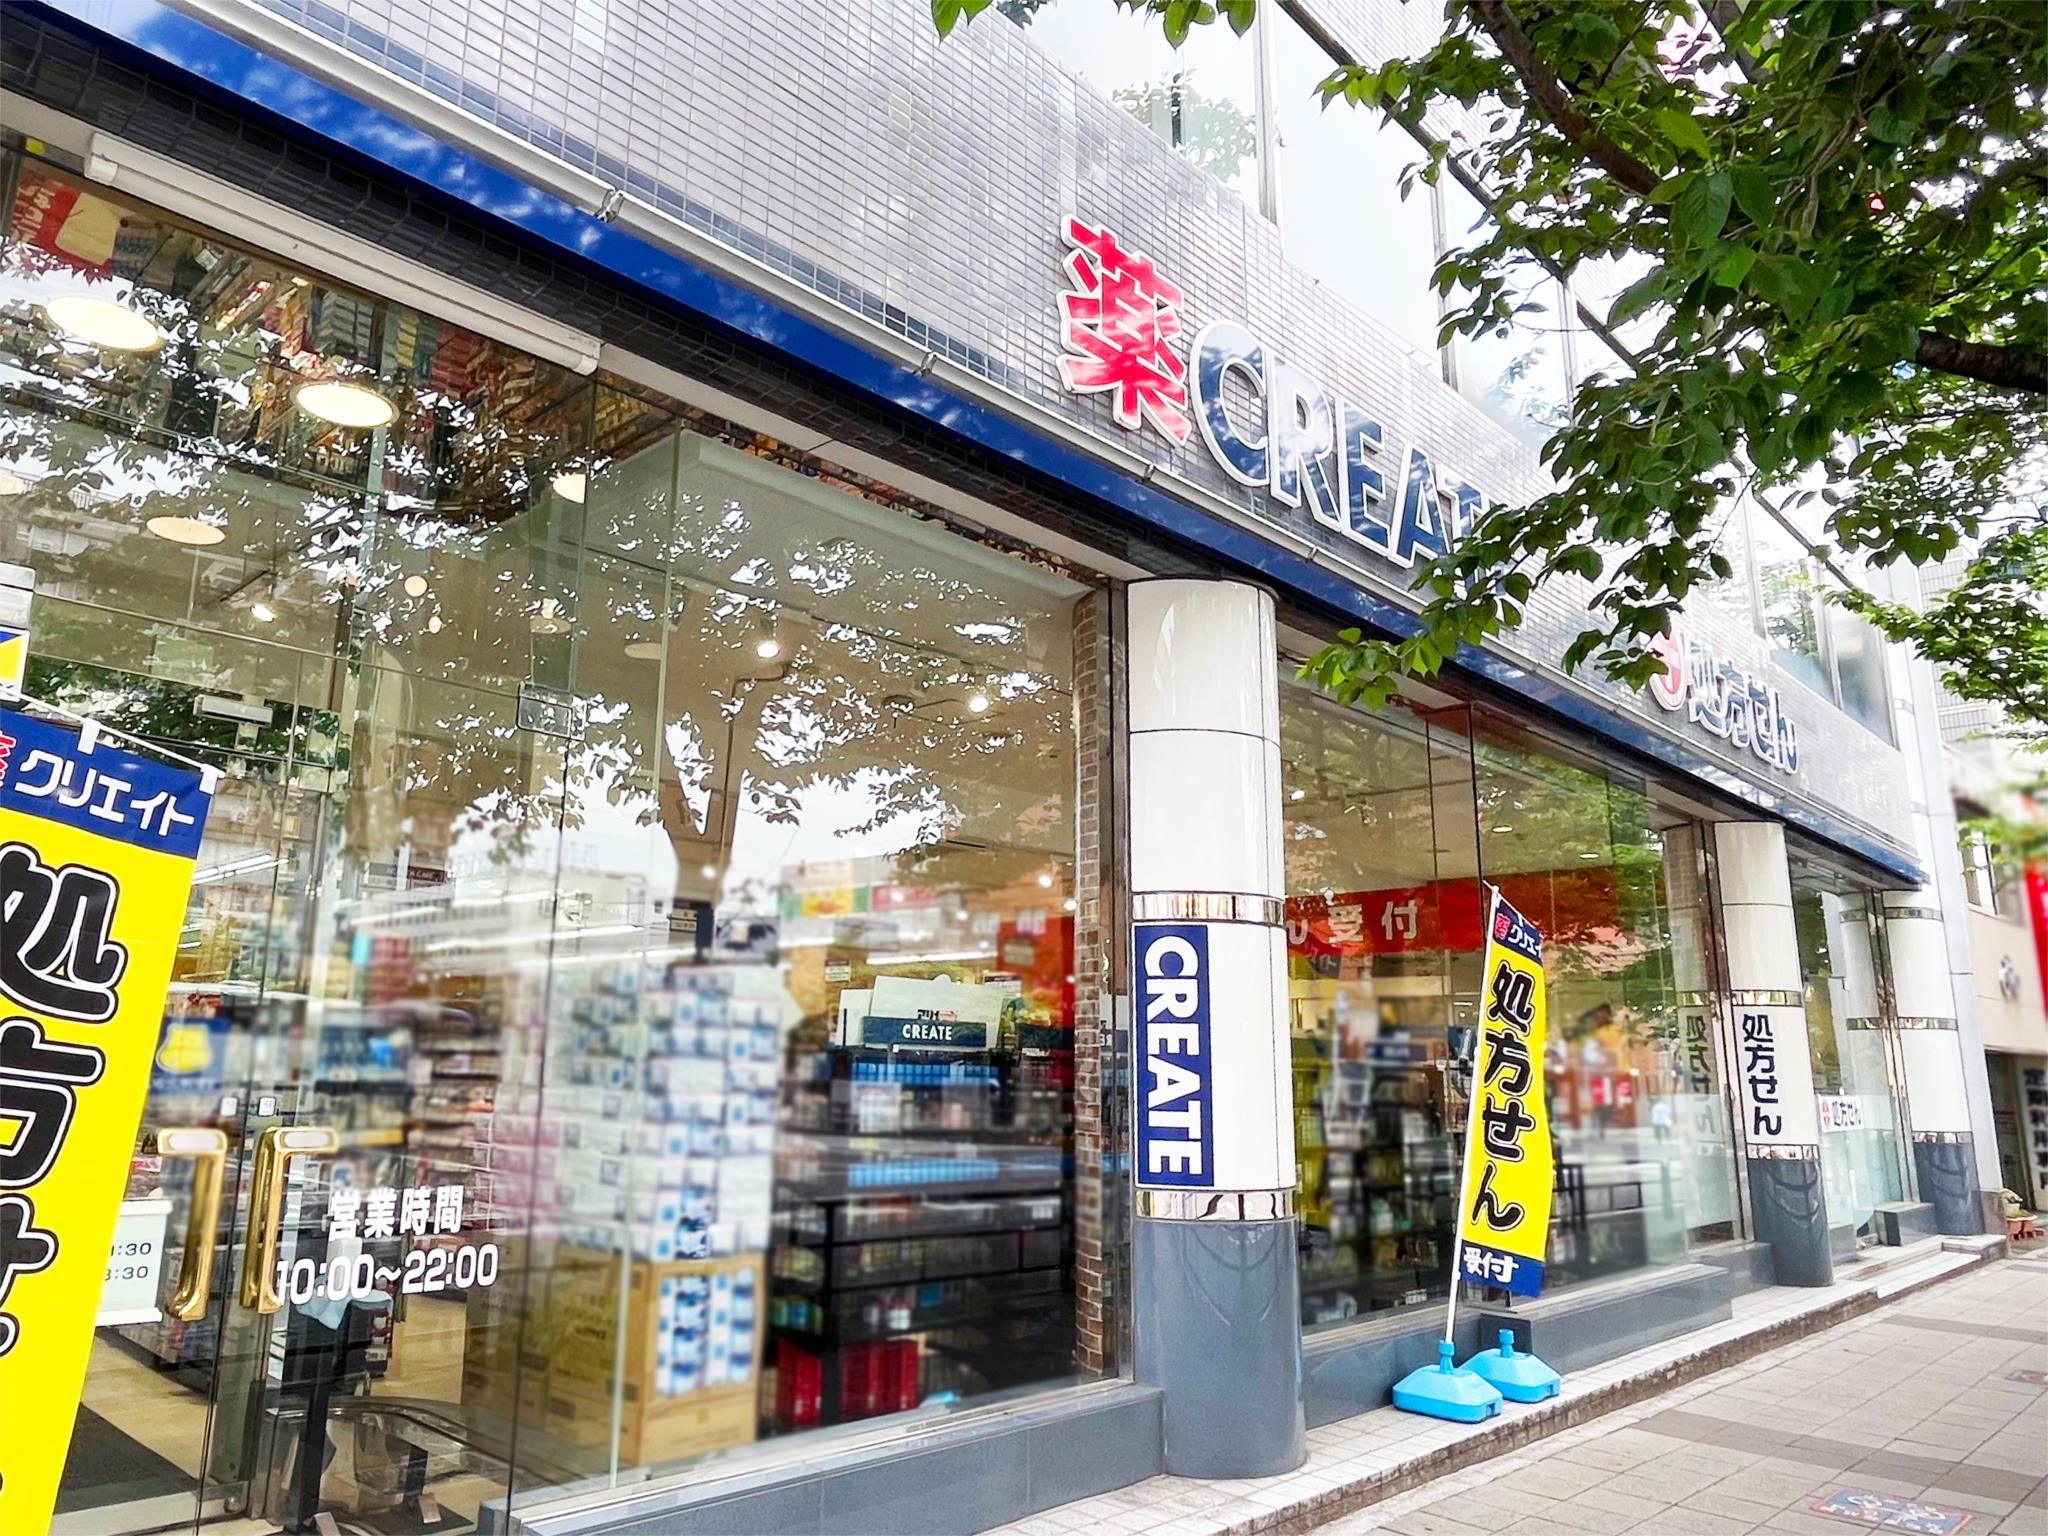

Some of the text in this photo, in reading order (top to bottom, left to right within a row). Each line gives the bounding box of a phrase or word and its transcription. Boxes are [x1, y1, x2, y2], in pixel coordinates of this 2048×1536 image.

[1056, 213, 1192, 448] 薬
[1189, 321, 1527, 632] CREAT
[1688, 638, 1800, 775] 処方せん
[14, 749, 196, 837] クリエイト
[902, 1024, 952, 1041] CREATE
[1144, 935, 1203, 1175] CREATE
[1471, 959, 1537, 1232] 処方せん
[1742, 1013, 1782, 1136] 処方せん
[328, 1184, 465, 1242] 営業時間
[1463, 1246, 1519, 1284] 受付
